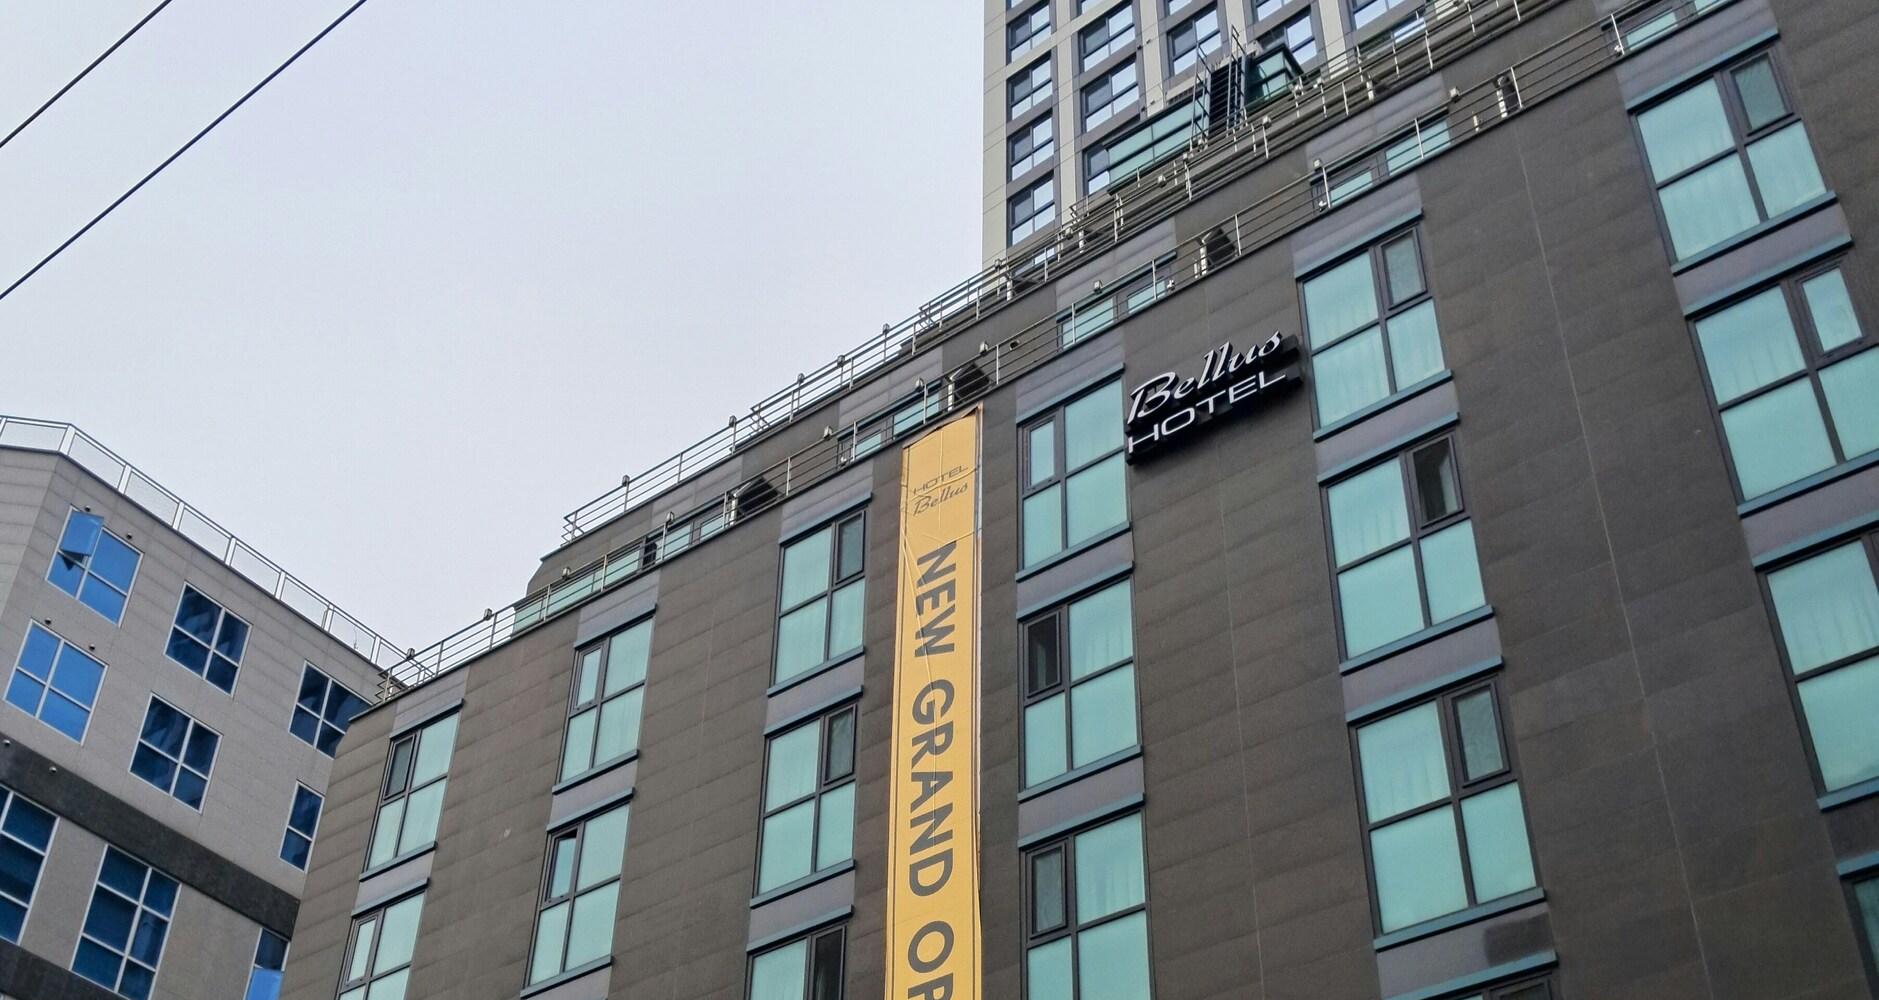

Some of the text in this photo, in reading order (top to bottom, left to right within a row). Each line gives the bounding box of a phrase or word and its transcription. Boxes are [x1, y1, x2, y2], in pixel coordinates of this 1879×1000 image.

[1127, 330, 1282, 425] Bellus
[1128, 371, 1286, 454] HOTEL
[913, 465, 968, 495] HOTEL
[913, 483, 968, 517] Bellus
[914, 540, 957, 658] NEW
[909, 679, 955, 897] GRAND
